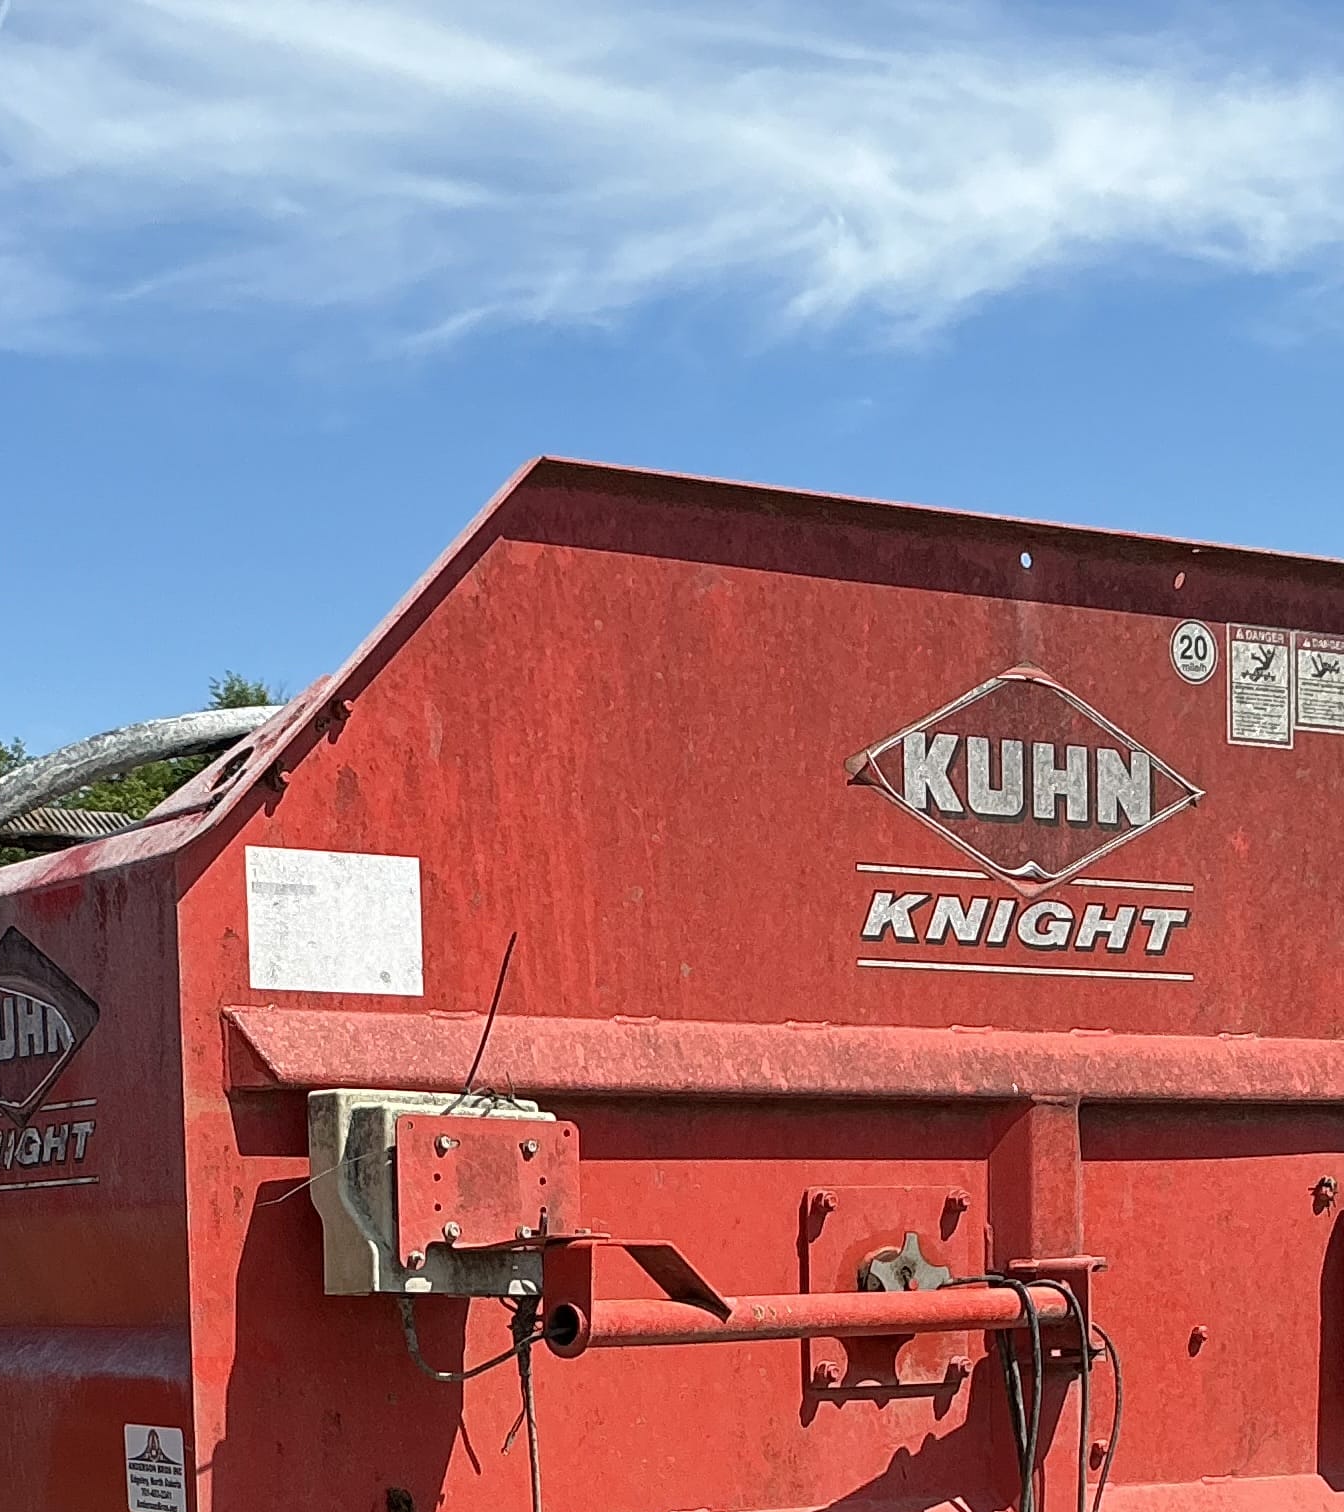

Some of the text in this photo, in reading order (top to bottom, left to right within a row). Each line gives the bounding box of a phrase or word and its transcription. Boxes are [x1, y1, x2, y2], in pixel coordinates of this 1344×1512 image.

[1179, 634, 1208, 661] 20
[1245, 629, 1286, 644] DANGER
[902, 730, 1153, 828] KUHN
[859, 890, 1190, 955] KNIGHT
